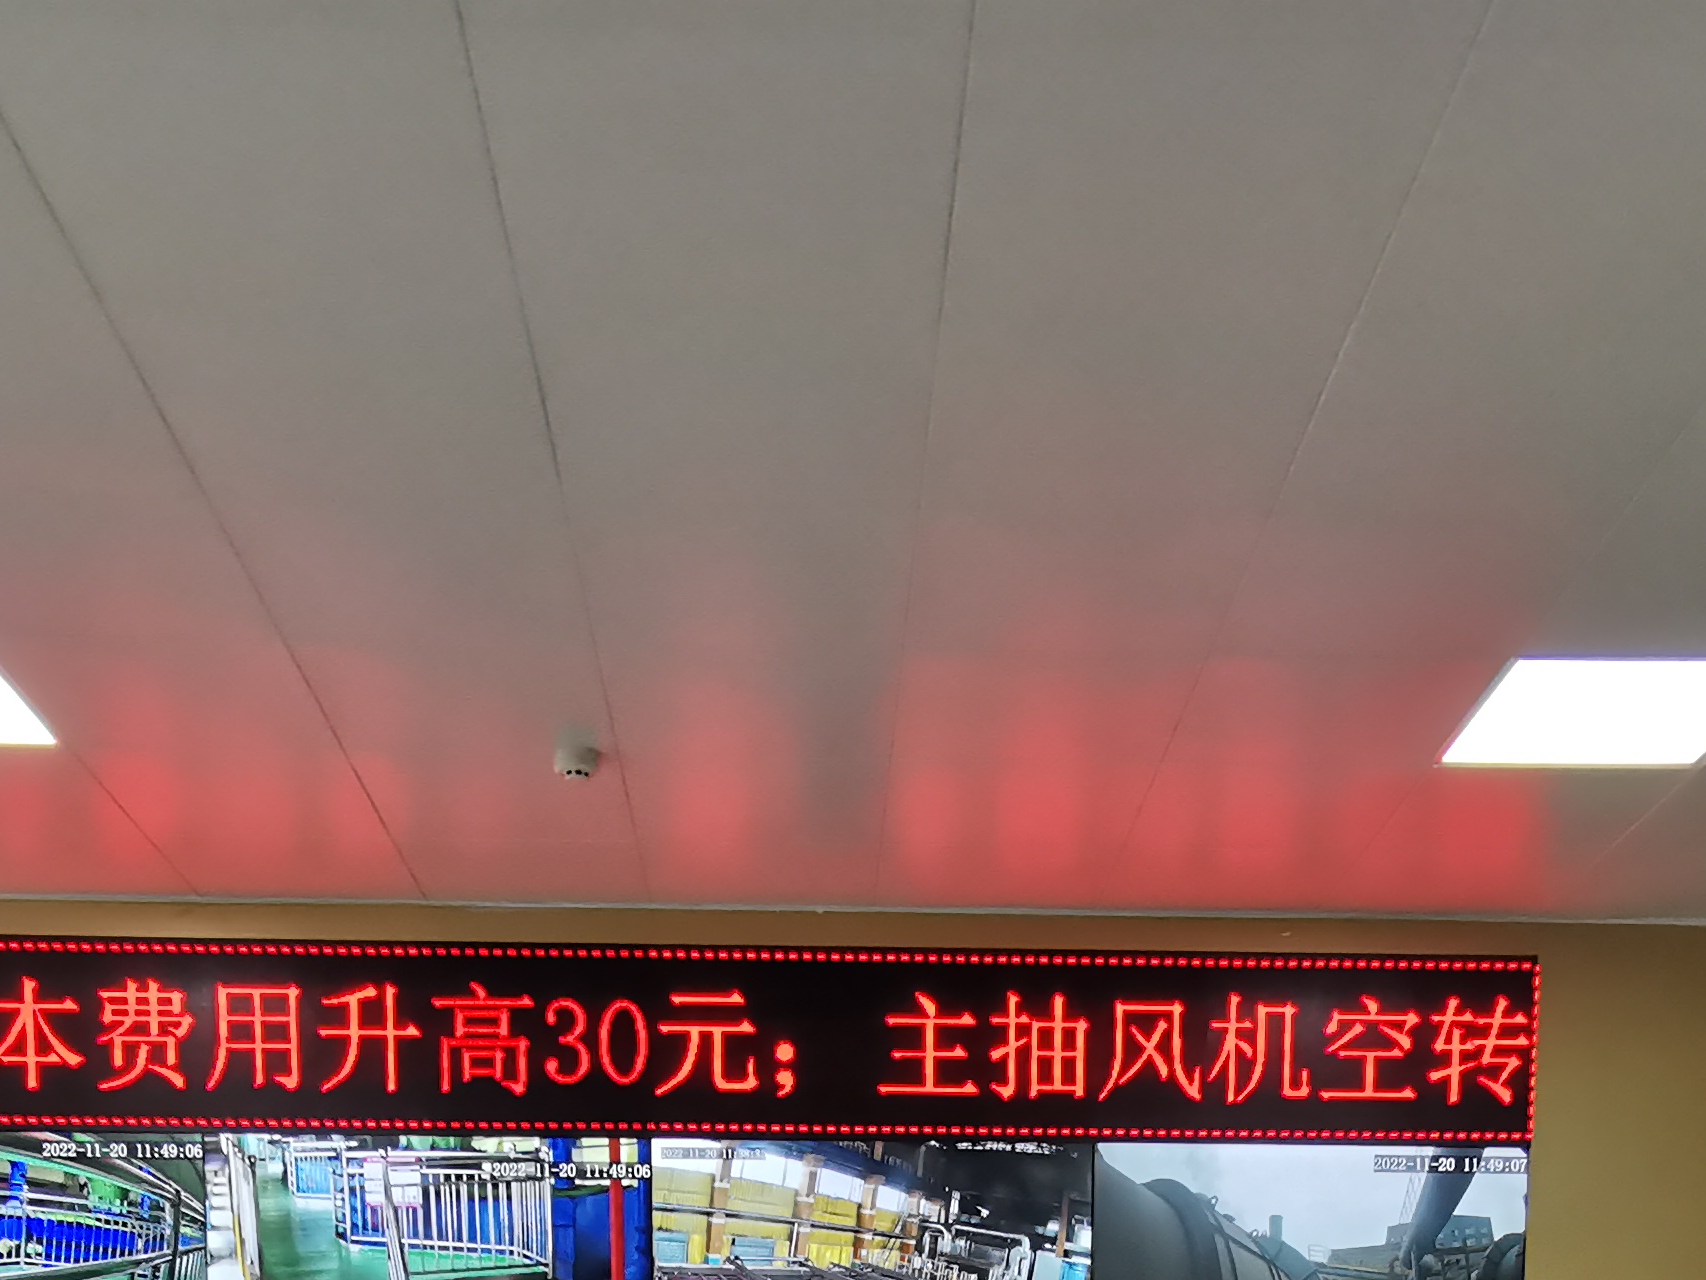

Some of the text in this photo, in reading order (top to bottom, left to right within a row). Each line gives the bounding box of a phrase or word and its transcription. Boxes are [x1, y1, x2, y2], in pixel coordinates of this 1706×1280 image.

[42, 1142, 204, 1159] 2022-11-20 11:49:06
[493, 1162, 651, 1179] 2022-11-20 11:49:06
[1374, 1156, 1528, 1173] 2022-11-20 11:49:07
